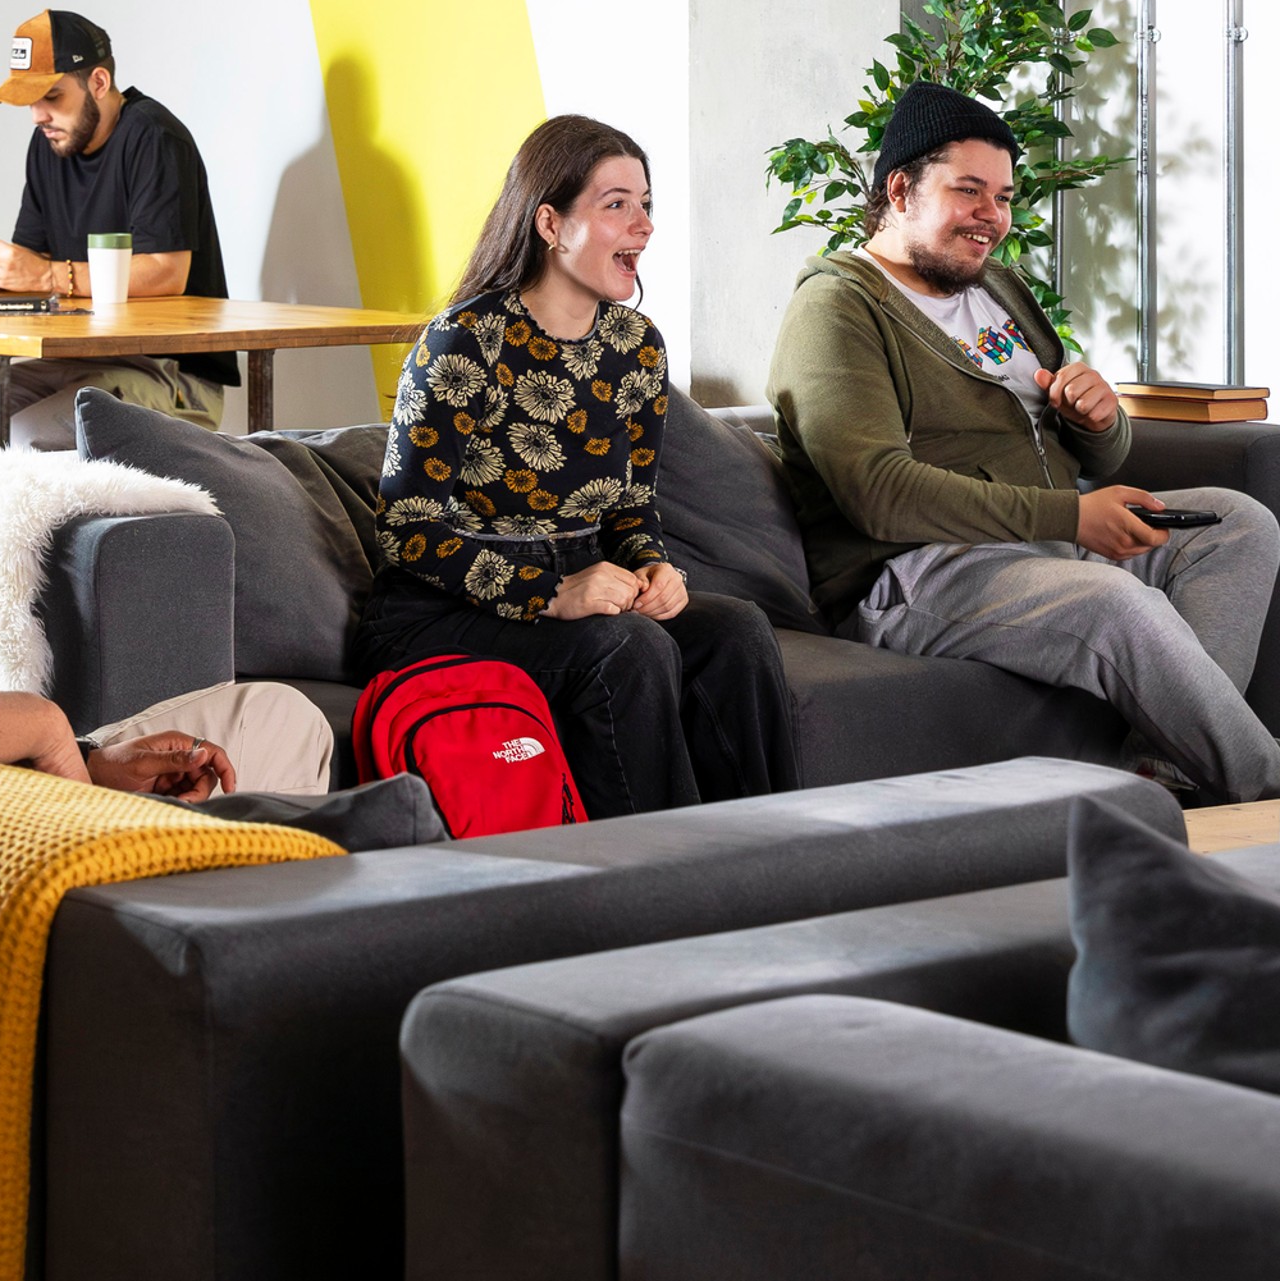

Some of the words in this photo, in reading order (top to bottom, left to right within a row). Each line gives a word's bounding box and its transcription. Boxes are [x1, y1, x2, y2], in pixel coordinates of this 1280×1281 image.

[502, 739, 522, 750] THE
[492, 745, 526, 760] NORTH
[505, 752, 528, 763] FACE
